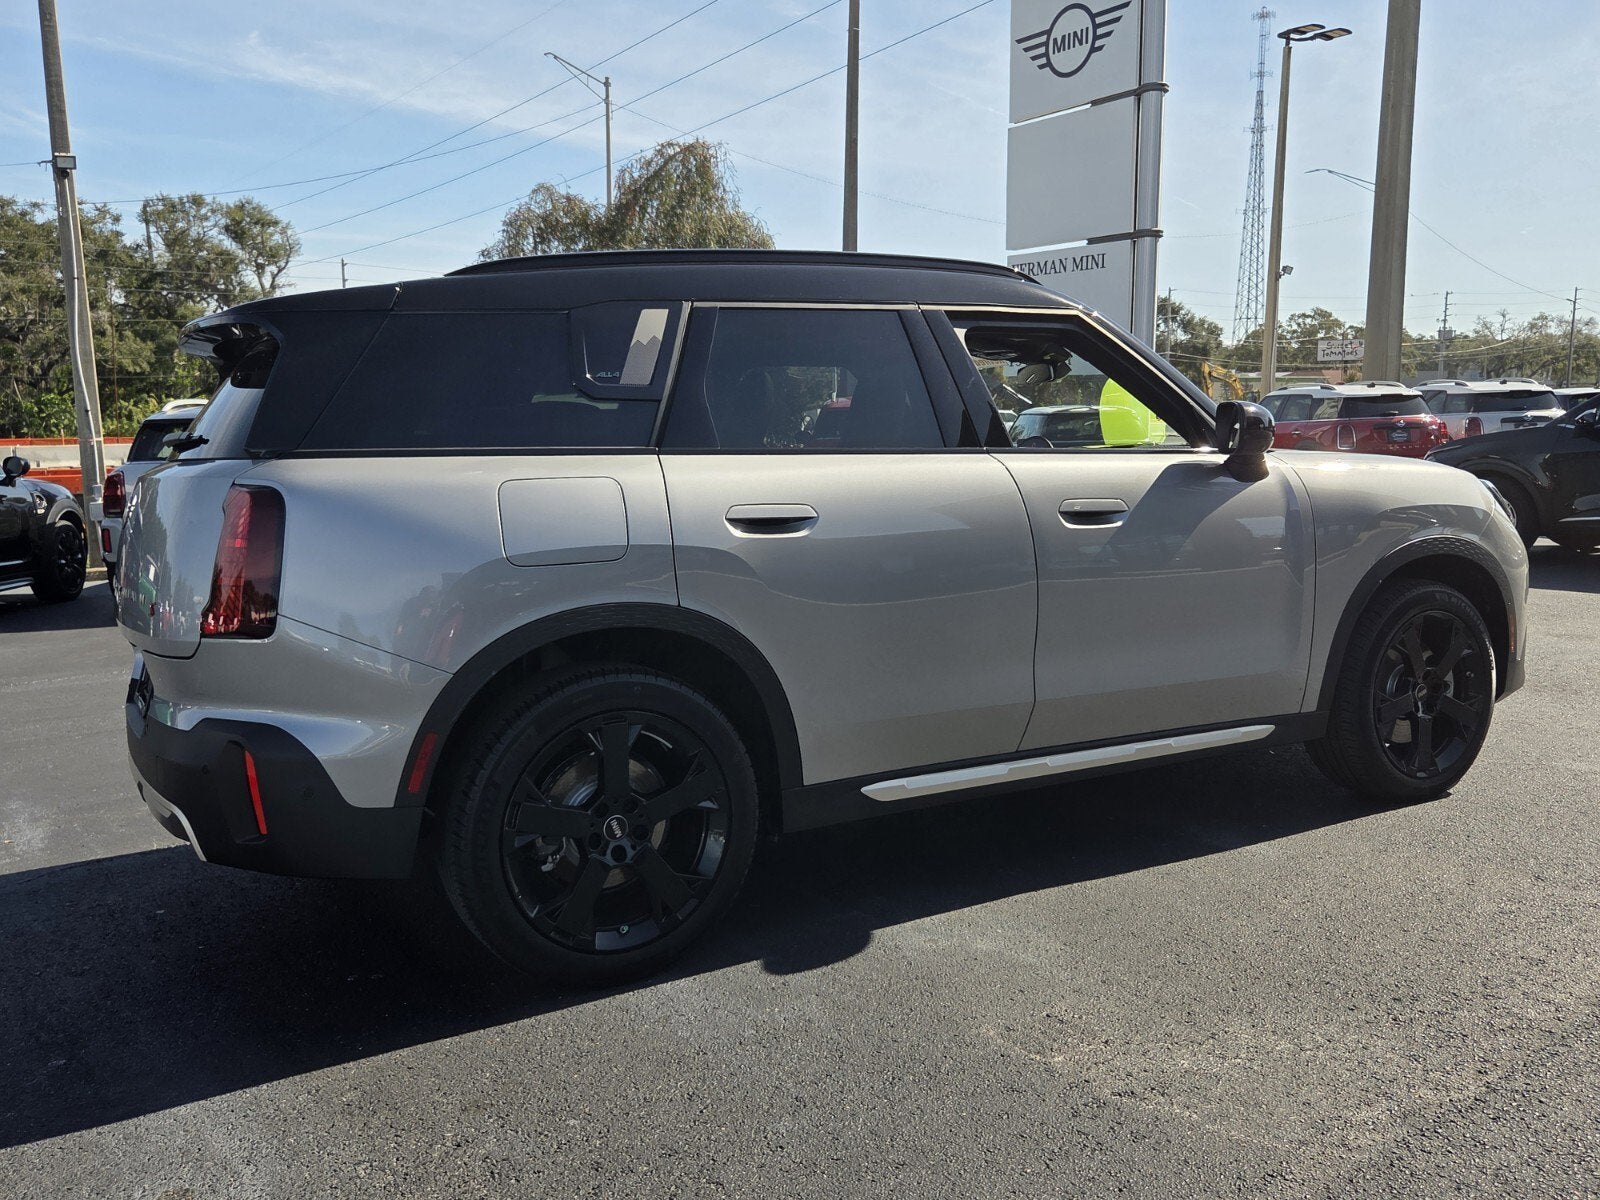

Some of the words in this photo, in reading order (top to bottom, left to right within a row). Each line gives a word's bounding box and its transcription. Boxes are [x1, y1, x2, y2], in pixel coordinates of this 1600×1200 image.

[1052, 26, 1089, 55] MINI
[1012, 258, 1068, 276] ERMAN
[1071, 253, 1106, 272] MINI
[609, 819, 623, 838] MINI
